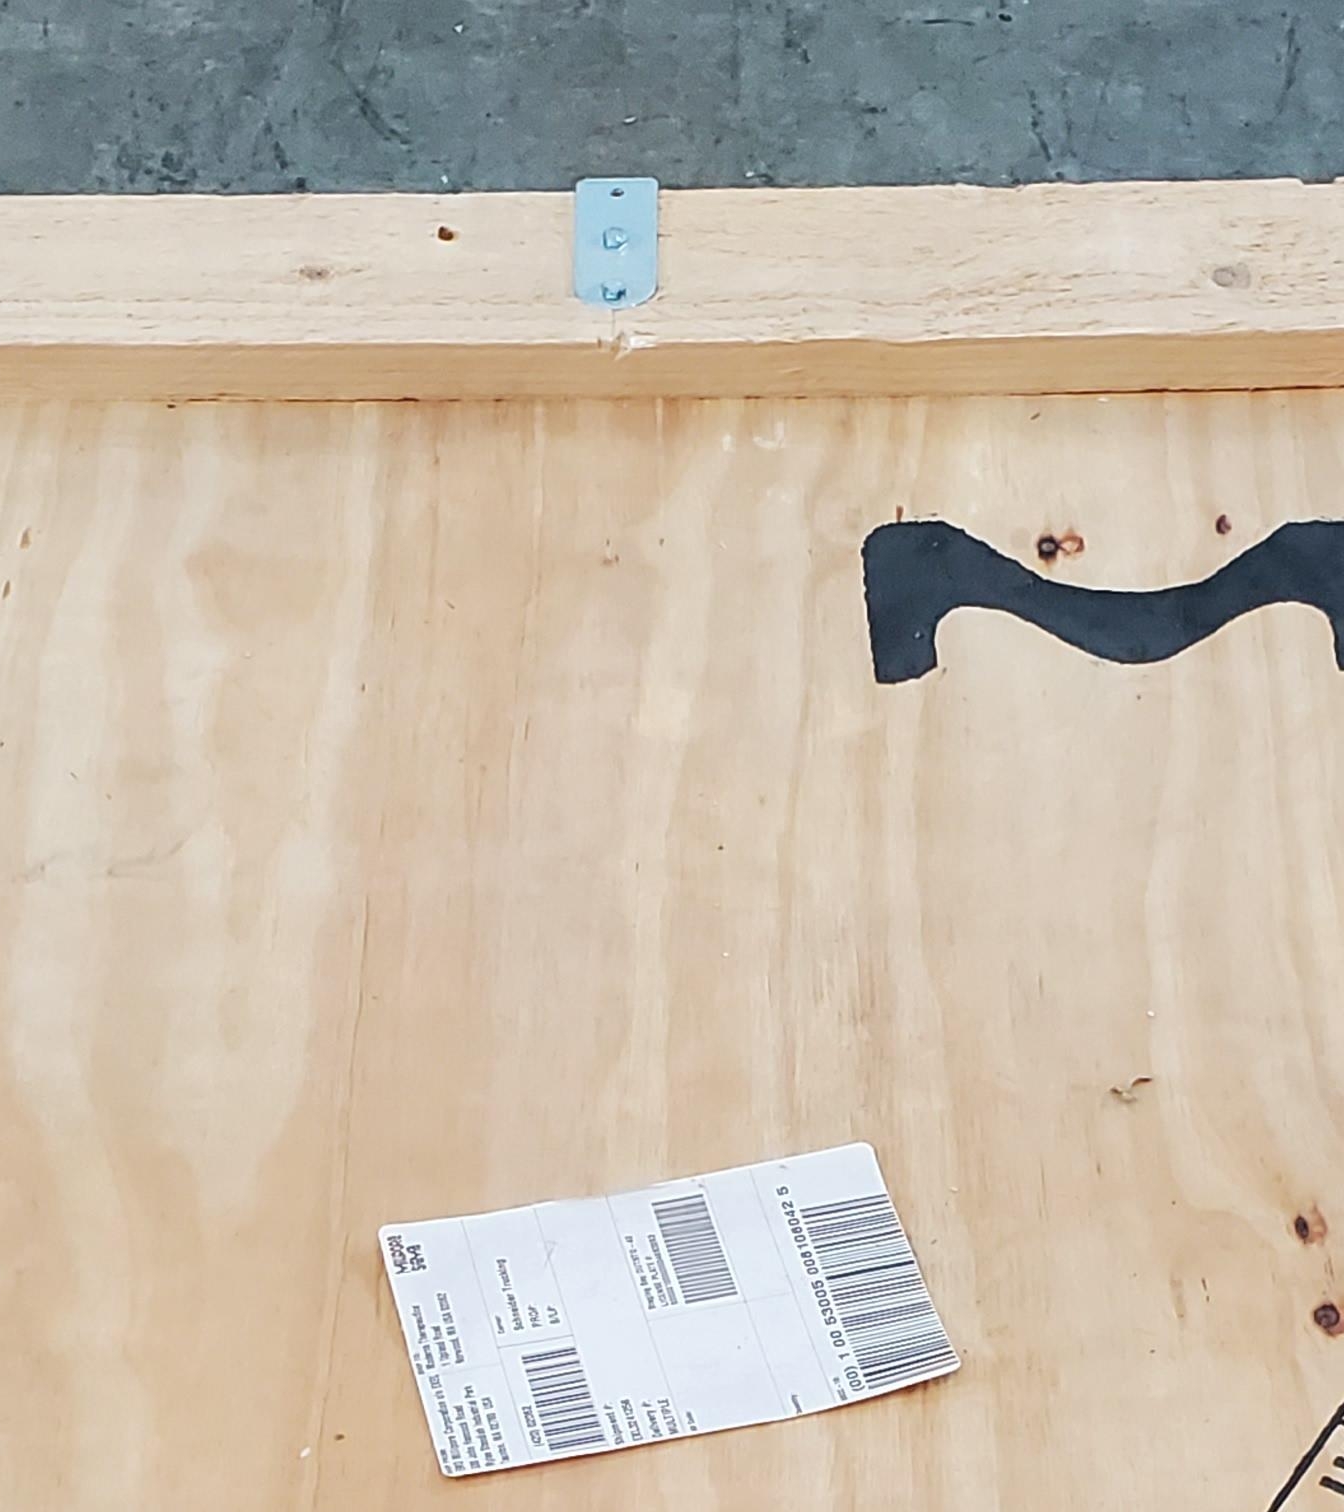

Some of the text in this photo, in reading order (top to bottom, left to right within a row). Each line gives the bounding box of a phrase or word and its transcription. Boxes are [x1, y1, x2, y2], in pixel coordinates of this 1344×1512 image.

[776, 1185, 788, 1195] 5
[493, 1258, 525, 1331] Schneider Trucking
[811, 1279, 836, 1325] 53005
[829, 1330, 845, 1347] 00
[837, 1350, 850, 1361] 1
[844, 1365, 864, 1391] (00)
